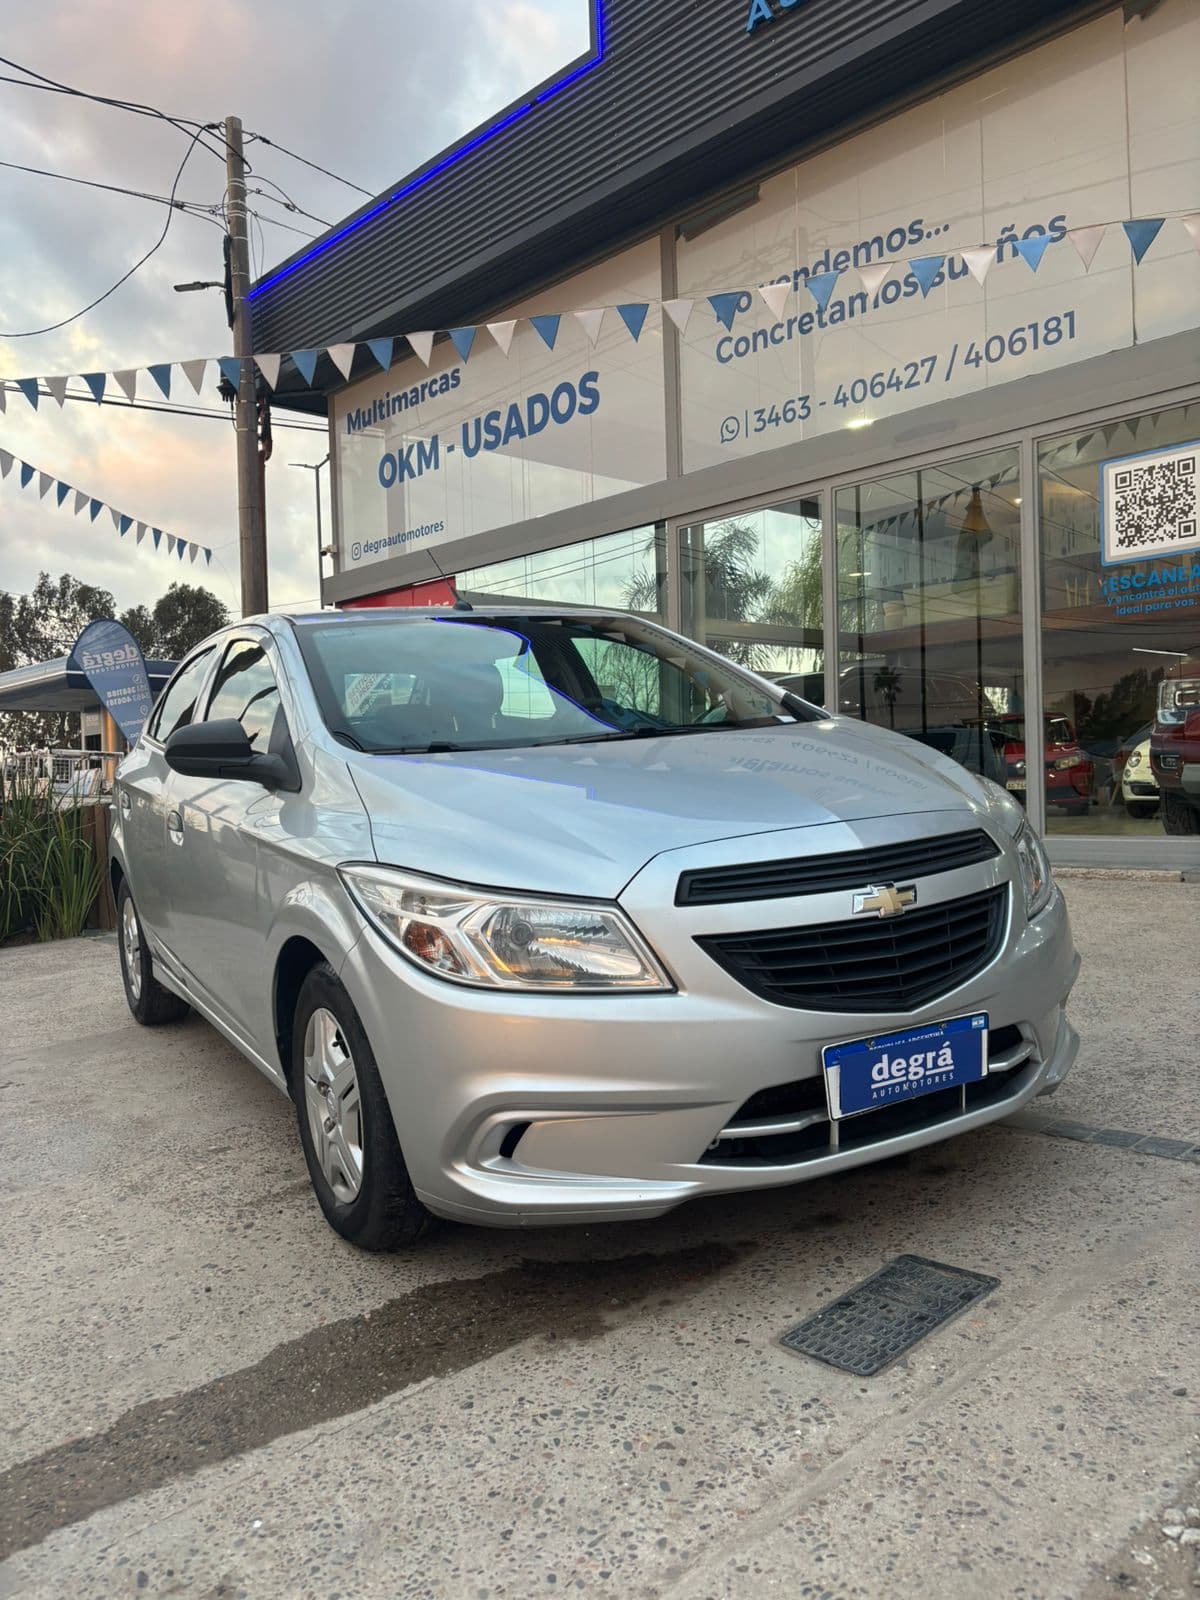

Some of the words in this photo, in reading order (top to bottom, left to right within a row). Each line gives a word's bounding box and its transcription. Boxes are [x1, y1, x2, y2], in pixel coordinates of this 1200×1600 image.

[715, 271, 920, 364] Concretamos
[753, 396, 811, 434] 3463
[833, 356, 937, 408] 406427
[963, 310, 1078, 370] 406181
[346, 367, 461, 434] Multimarcas
[461, 370, 601, 458] USADOS
[362, 520, 444, 553] degraautomotores
[1116, 603, 1143, 616] ideal
[1145, 601, 1172, 614] para
[1174, 597, 1198, 608] vos.
[1167, 585, 1178, 597] el
[871, 1041, 954, 1082] degrá
[872, 1073, 954, 1100] AUTOMOTORES
